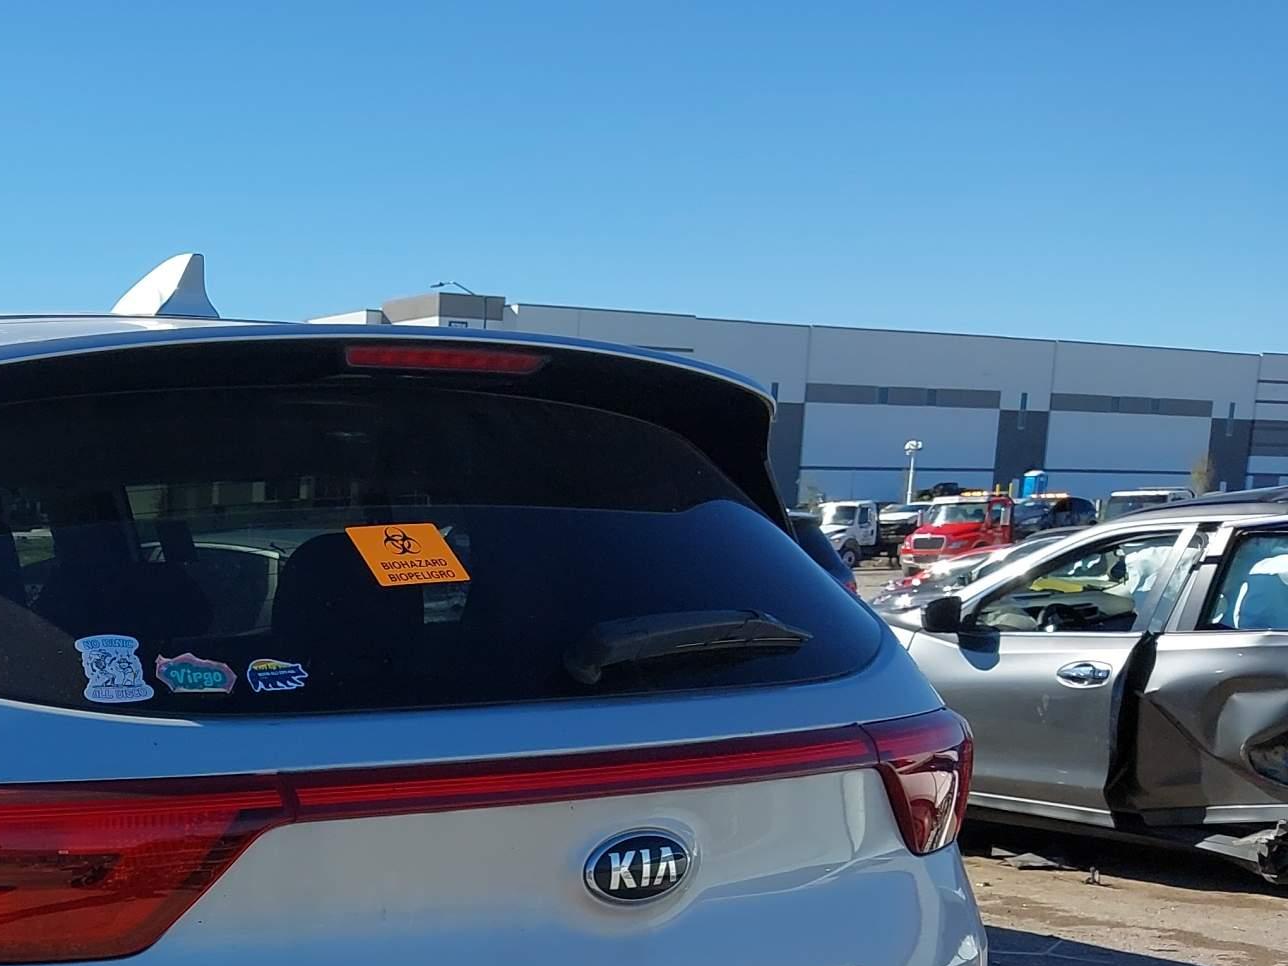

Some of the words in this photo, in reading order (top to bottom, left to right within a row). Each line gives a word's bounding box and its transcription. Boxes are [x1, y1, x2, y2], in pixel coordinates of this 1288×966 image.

[380, 558, 448, 571] BIOHAZARD
[388, 569, 456, 582] BIOPELIGRO
[170, 668, 223, 687] Virgo
[608, 846, 677, 890] KIA
